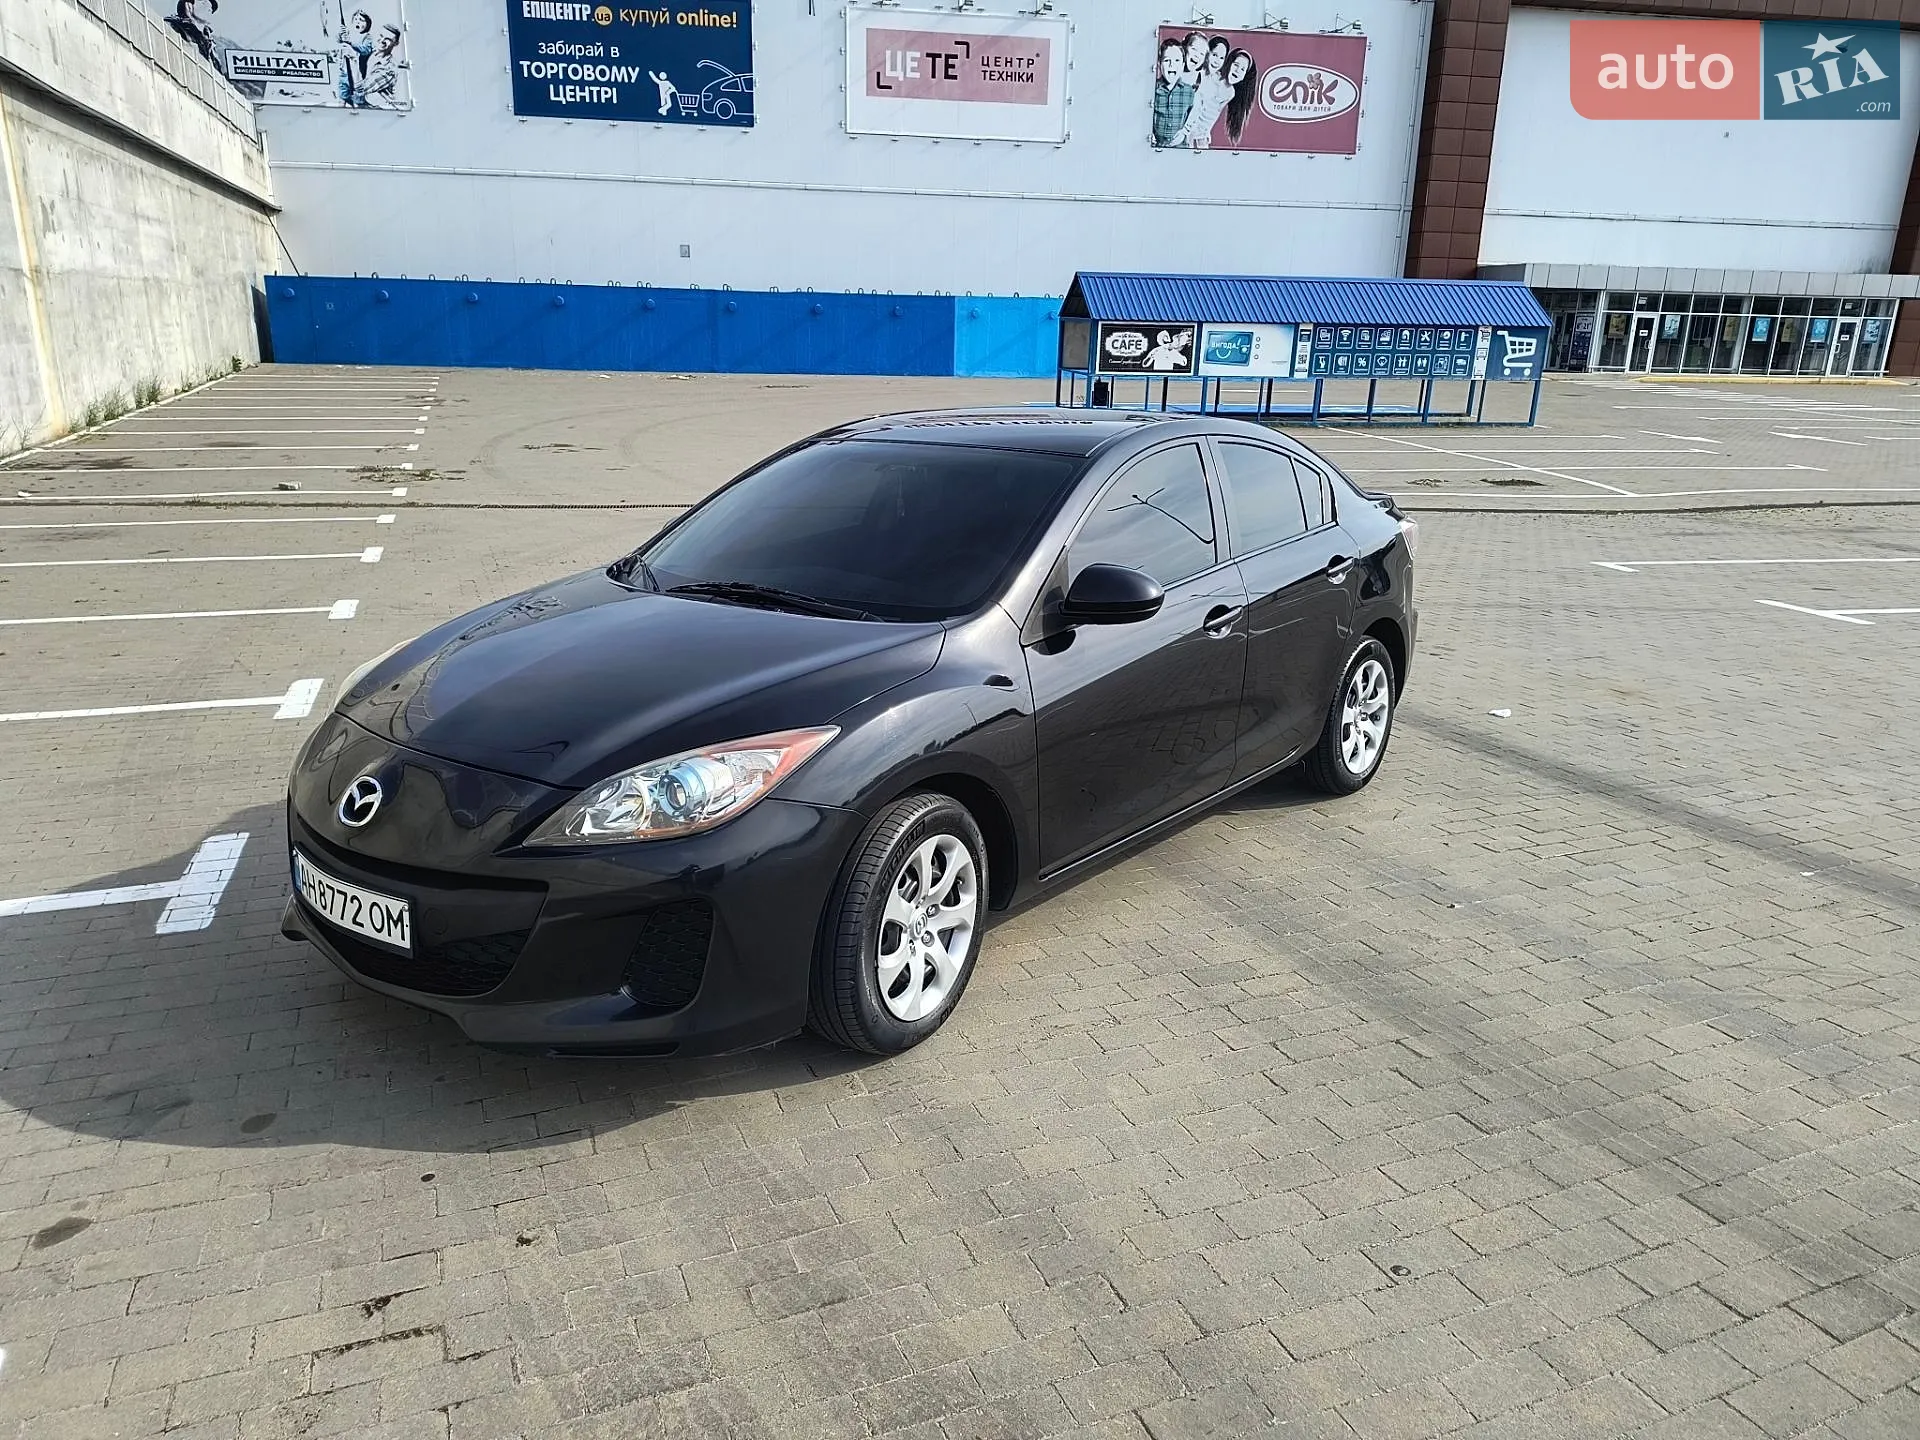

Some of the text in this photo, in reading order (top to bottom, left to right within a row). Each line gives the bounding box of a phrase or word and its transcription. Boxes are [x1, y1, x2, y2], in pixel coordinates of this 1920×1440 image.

[619, 8, 670, 28] купуй
[676, 11, 738, 28] online!
[538, 40, 620, 60] забирай в
[232, 55, 322, 70] MILITARY
[981, 55, 1035, 69] ЦЕНТР
[519, 60, 640, 83] ТОРГОВОМУ
[981, 69, 1034, 84] ТЕХНІКИ
[549, 83, 618, 105] ЦЕНТРІ
[1111, 339, 1143, 350] CAFE
